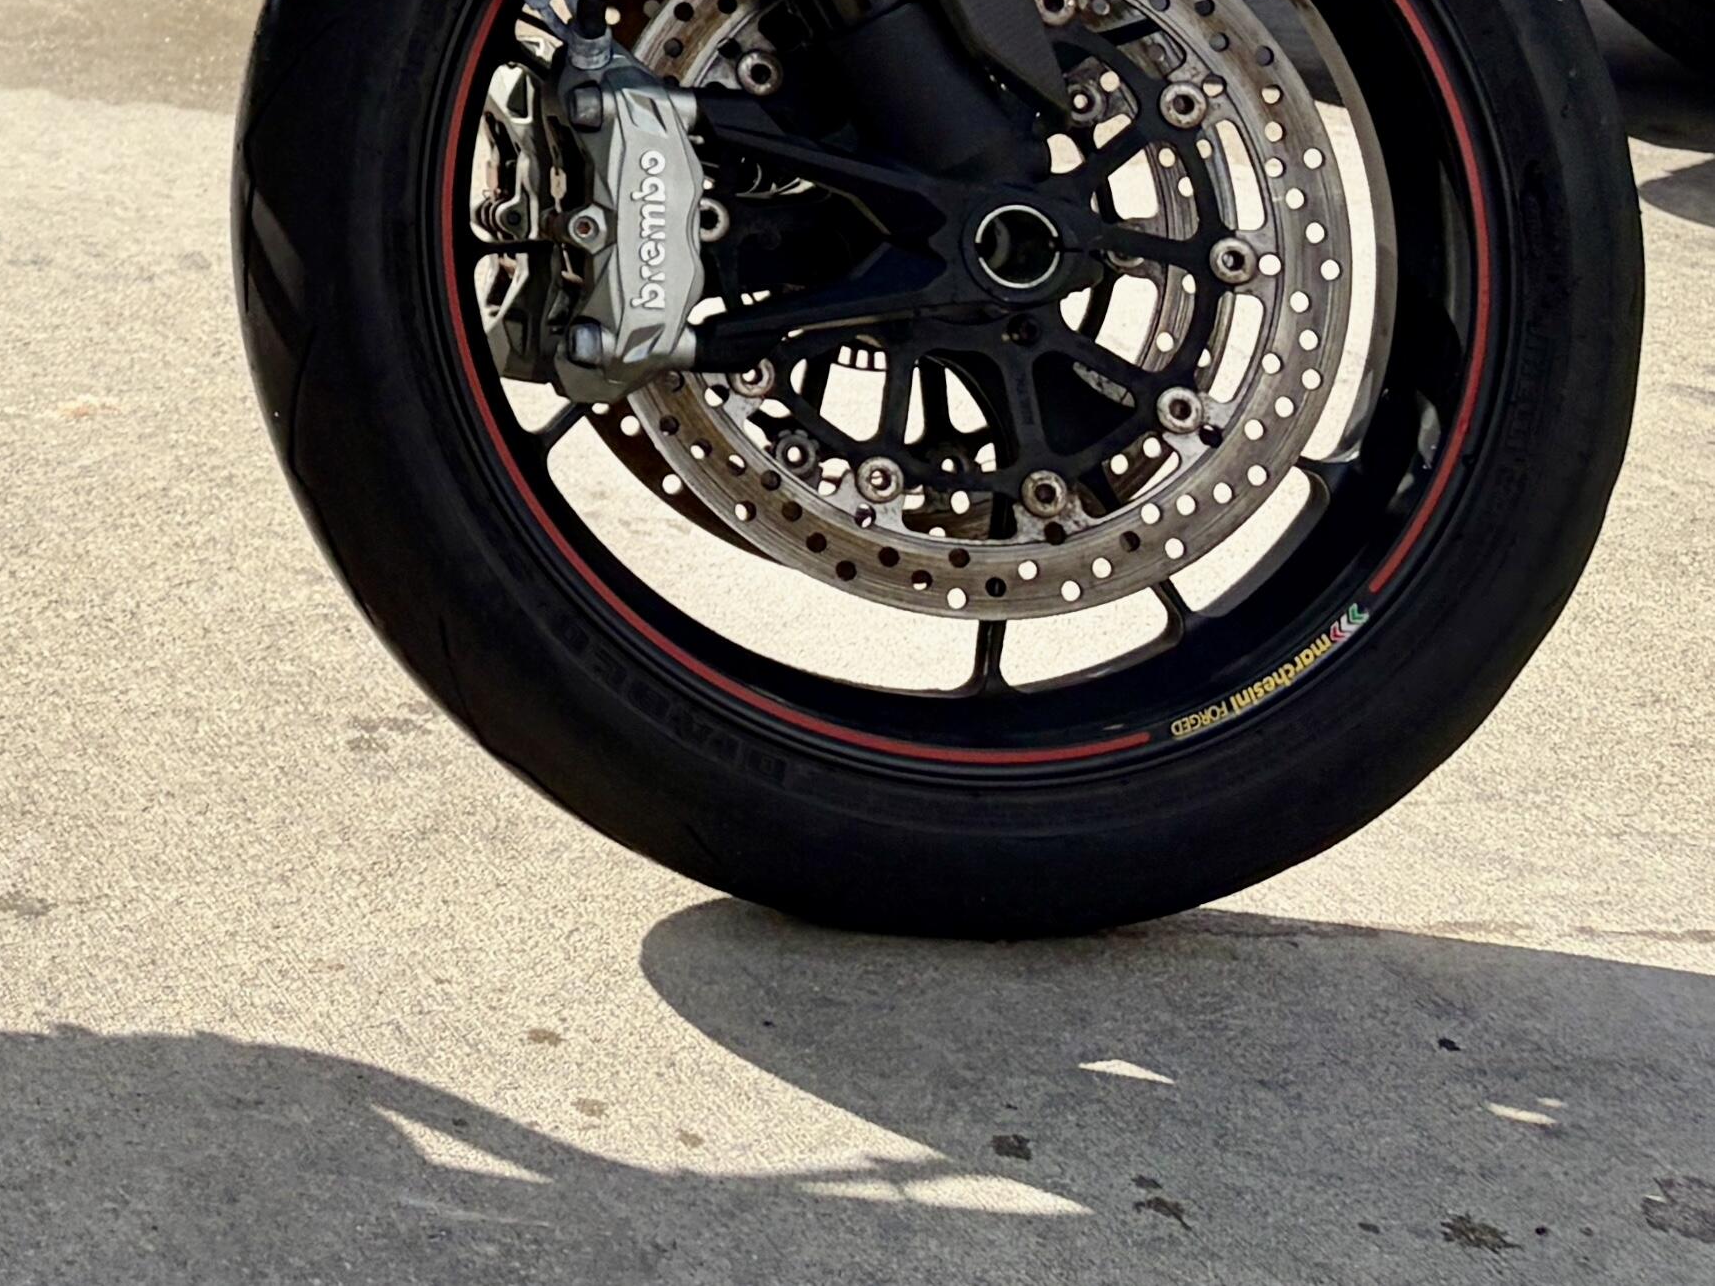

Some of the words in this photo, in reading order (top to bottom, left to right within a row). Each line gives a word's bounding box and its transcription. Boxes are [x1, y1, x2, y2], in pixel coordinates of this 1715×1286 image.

[630, 149, 666, 310] brembo
[1229, 633, 1332, 717] marchesini
[1170, 700, 1229, 736] FORGED
